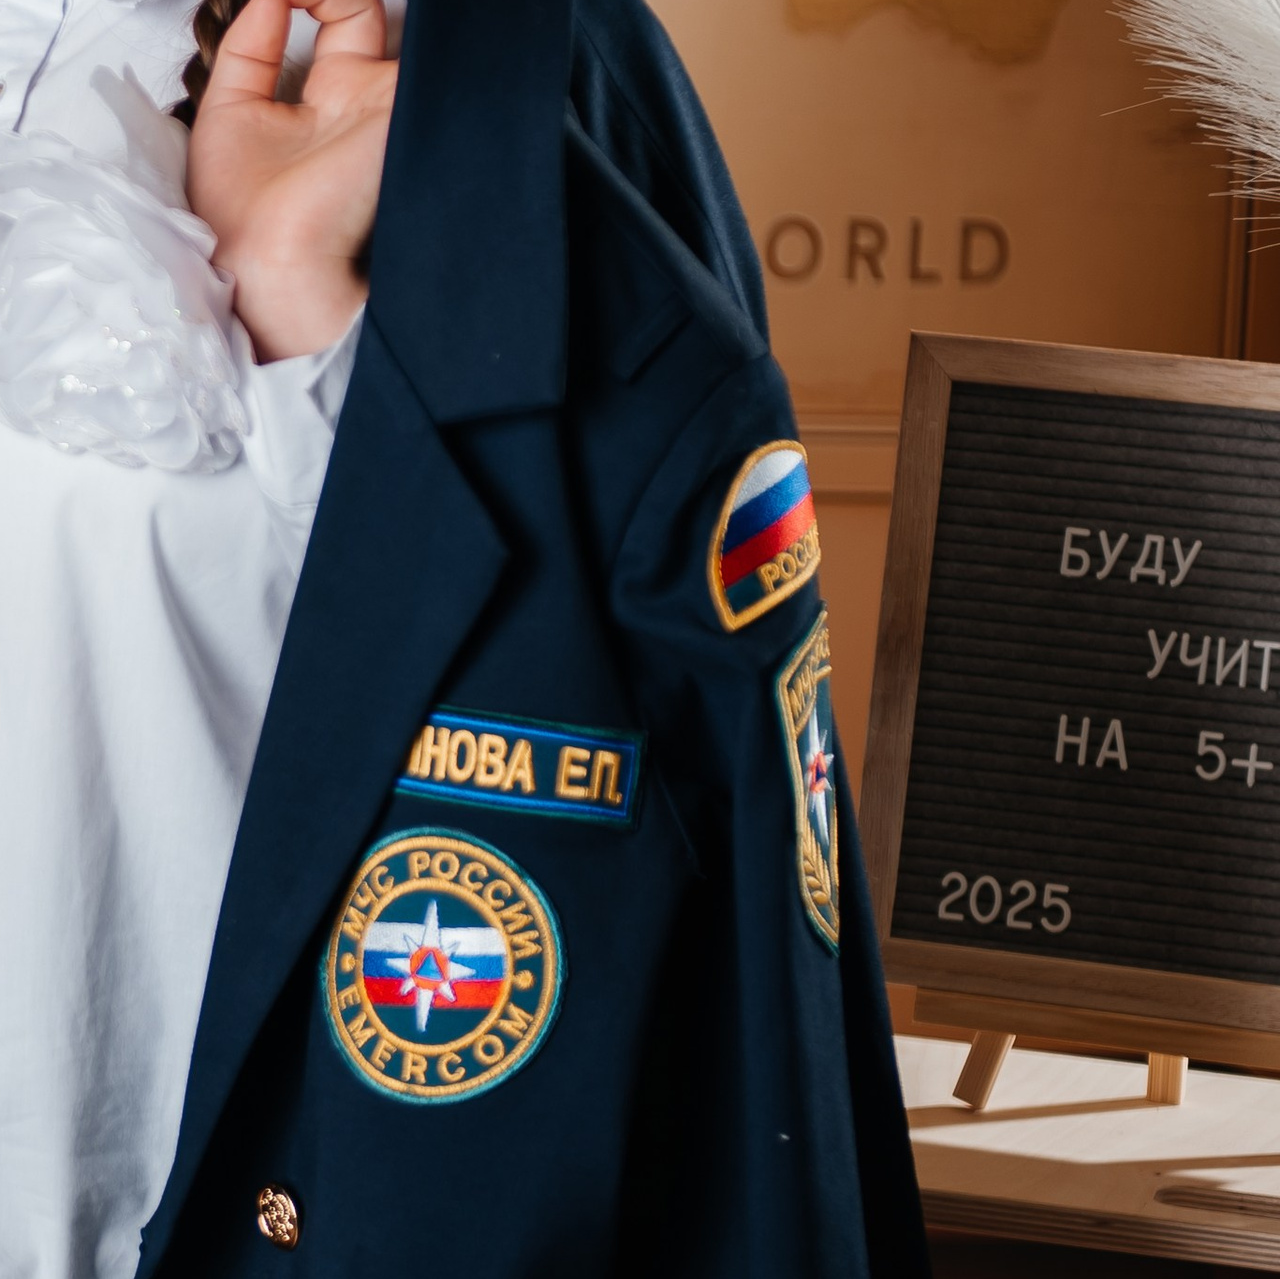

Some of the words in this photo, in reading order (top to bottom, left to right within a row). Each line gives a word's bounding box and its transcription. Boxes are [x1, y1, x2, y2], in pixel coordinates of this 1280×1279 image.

[765, 214, 1010, 285] ORLD
[1059, 525, 1203, 589] БУДУ
[1146, 628, 1280, 693] УЧИТ
[1054, 714, 1129, 771] НА
[1194, 730, 1274, 789] 5+
[341, 862, 397, 942] МЧС
[407, 850, 543, 961] РОССИИ
[937, 870, 1073, 935] 2025
[334, 984, 536, 1085] EMERCOM
